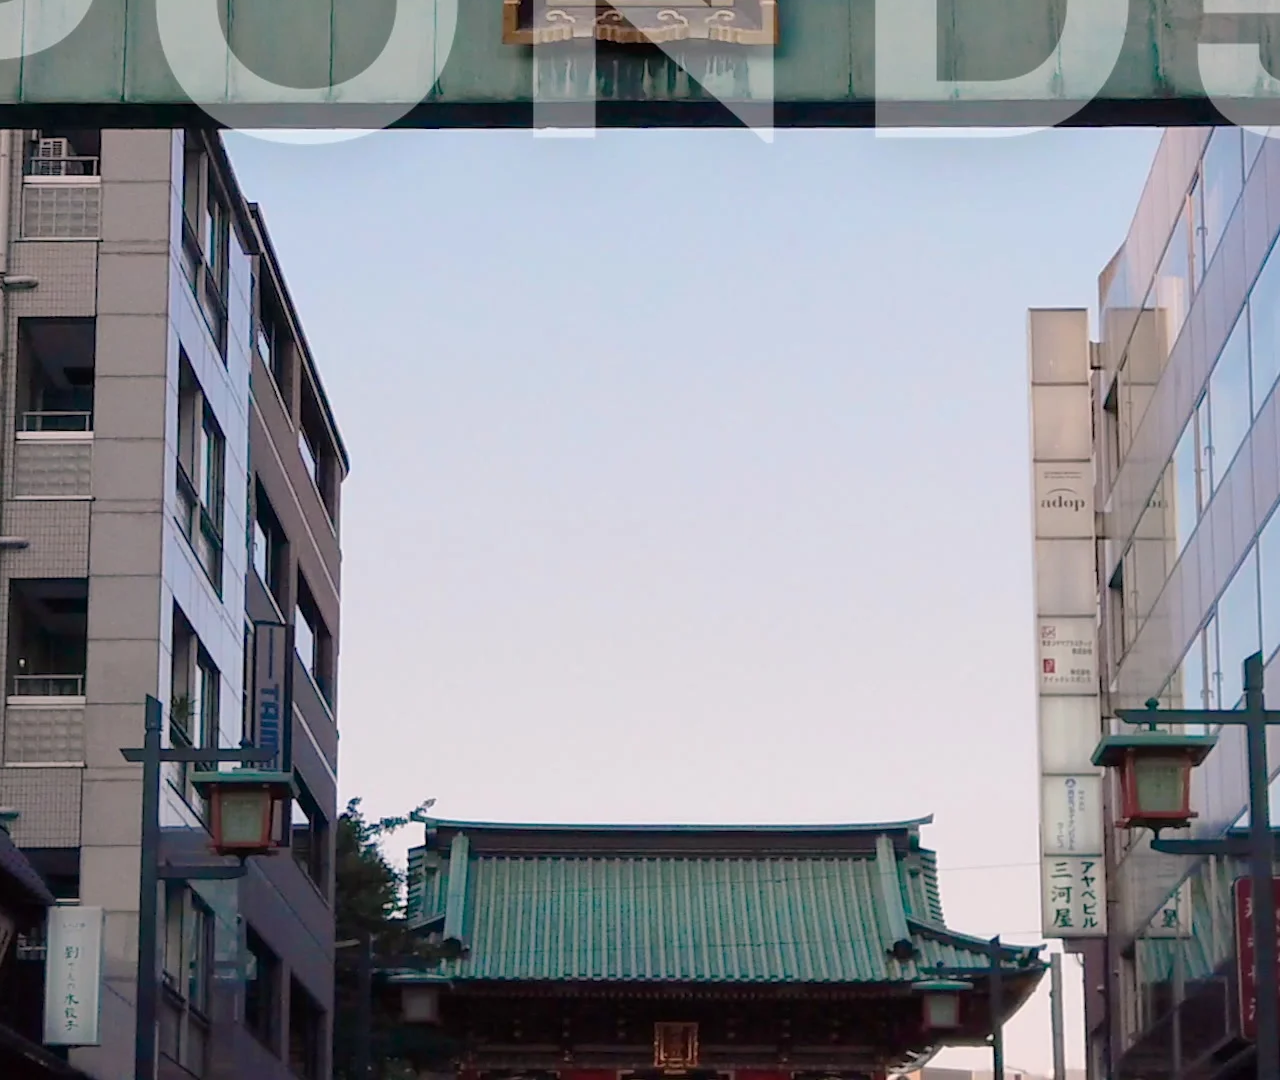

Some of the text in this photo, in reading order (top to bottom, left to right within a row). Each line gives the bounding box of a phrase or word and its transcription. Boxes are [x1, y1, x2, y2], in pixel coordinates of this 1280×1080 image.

[1041, 495, 1086, 512] adop
[1050, 862, 1074, 928] 三河屋
[1081, 861, 1098, 928] アヤベビル
